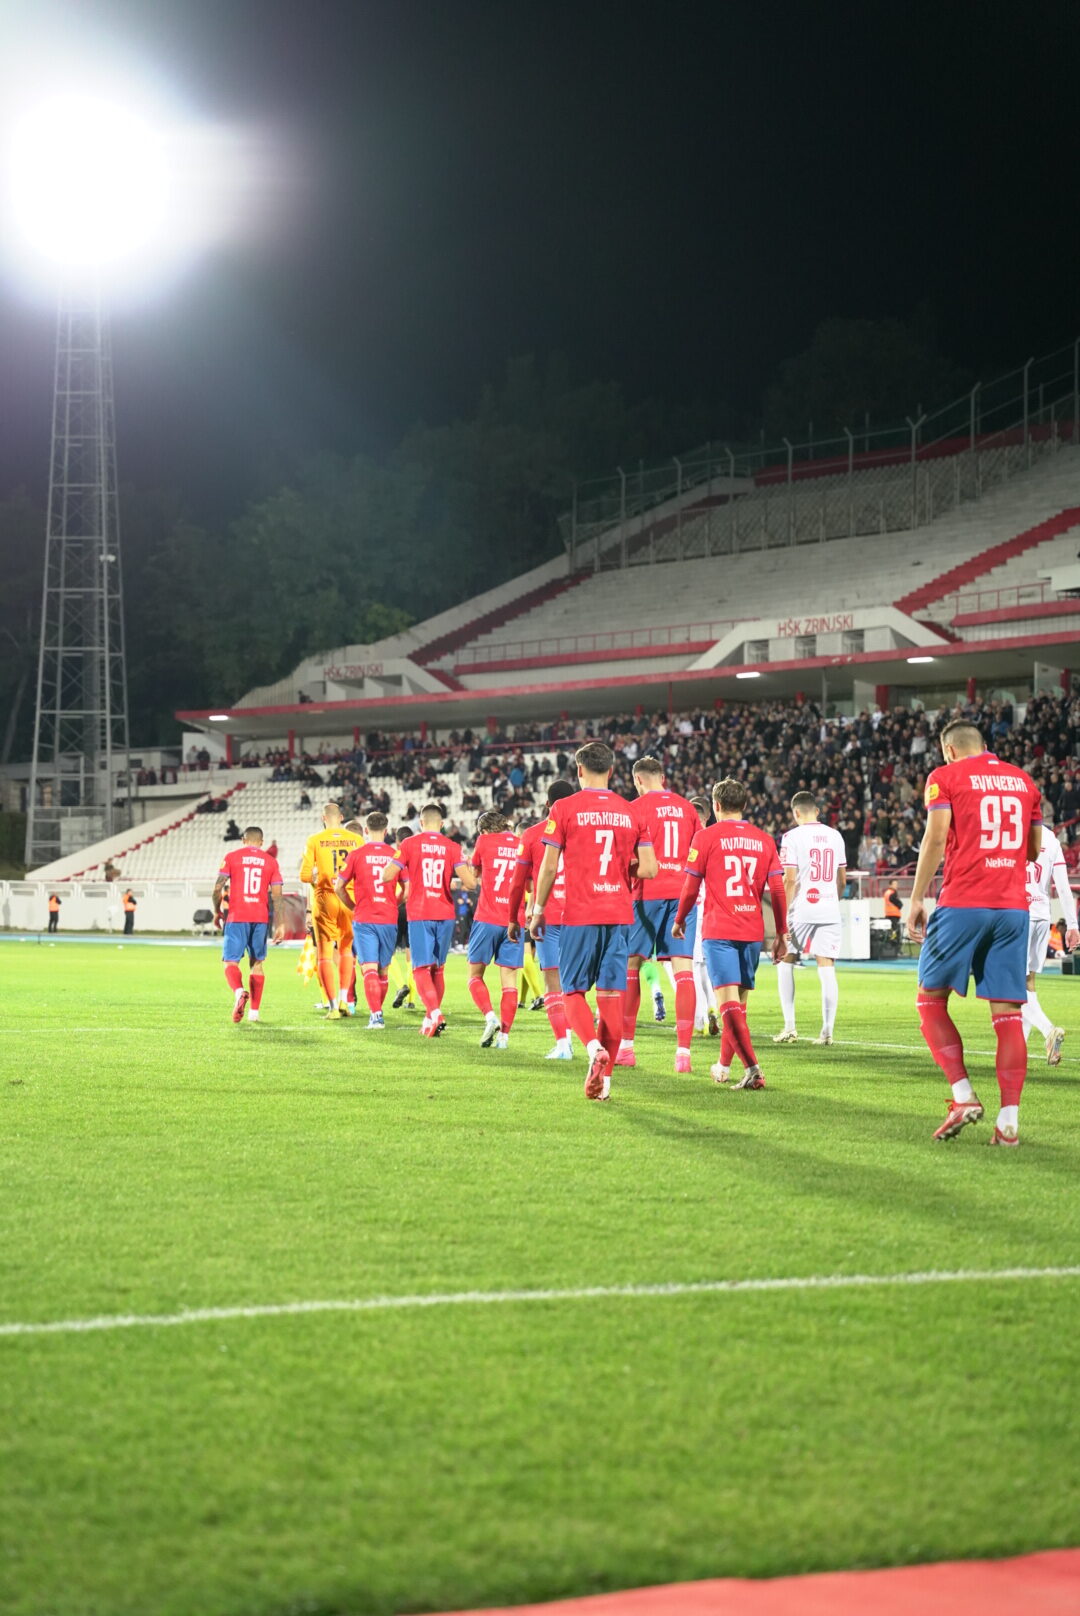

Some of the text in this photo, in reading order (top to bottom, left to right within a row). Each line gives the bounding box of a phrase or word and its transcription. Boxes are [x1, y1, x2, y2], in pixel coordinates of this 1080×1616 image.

[776, 614, 854, 639] HŠK ZRINJSKI
[969, 774, 1028, 793] ВУКЧЕВИЋ
[576, 811, 632, 829] СРЕЋКОВИЋ
[979, 795, 1023, 850] 93
[663, 820, 679, 858] 11
[719, 836, 764, 853] КУЛАШИН
[332, 849, 349, 874] 13
[595, 829, 615, 877] 7
[809, 848, 834, 883] 30
[985, 857, 1016, 869] Nektar
[243, 867, 262, 895] 16
[372, 865, 385, 894] 2
[421, 858, 445, 889] 88
[724, 855, 758, 897] 27
[593, 882, 621, 893] Nektar
[734, 903, 757, 913] Nektar
